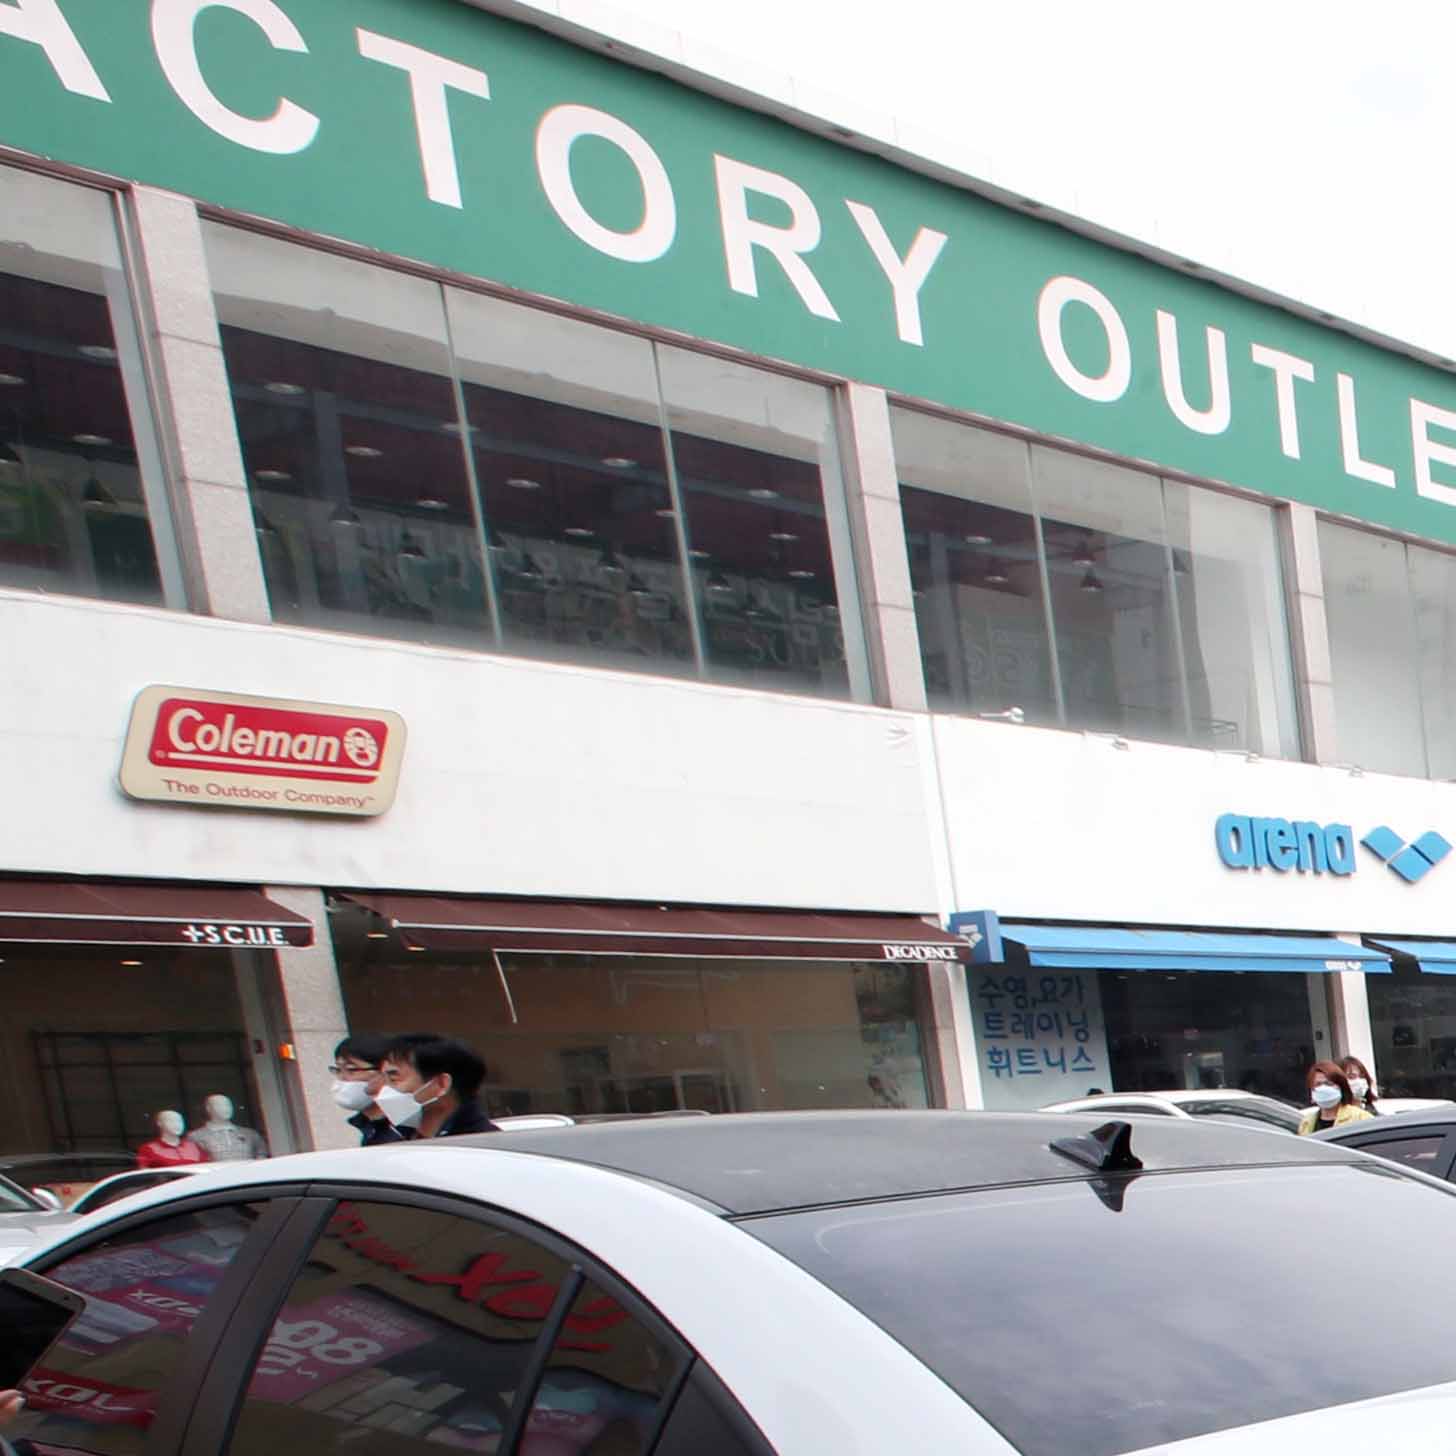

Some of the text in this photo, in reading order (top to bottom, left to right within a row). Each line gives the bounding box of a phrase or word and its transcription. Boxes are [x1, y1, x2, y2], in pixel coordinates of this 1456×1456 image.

[167, 707, 341, 763] Coleman
[161, 778, 200, 795] The
[205, 782, 279, 801] Outdoor
[1215, 812, 1357, 876] arena
[883, 944, 959, 961] DECADENCE
[978, 974, 1085, 1010] 수영,요가
[983, 1009, 1091, 1044] 트레이닝
[986, 1045, 1096, 1079] 휘트니스
